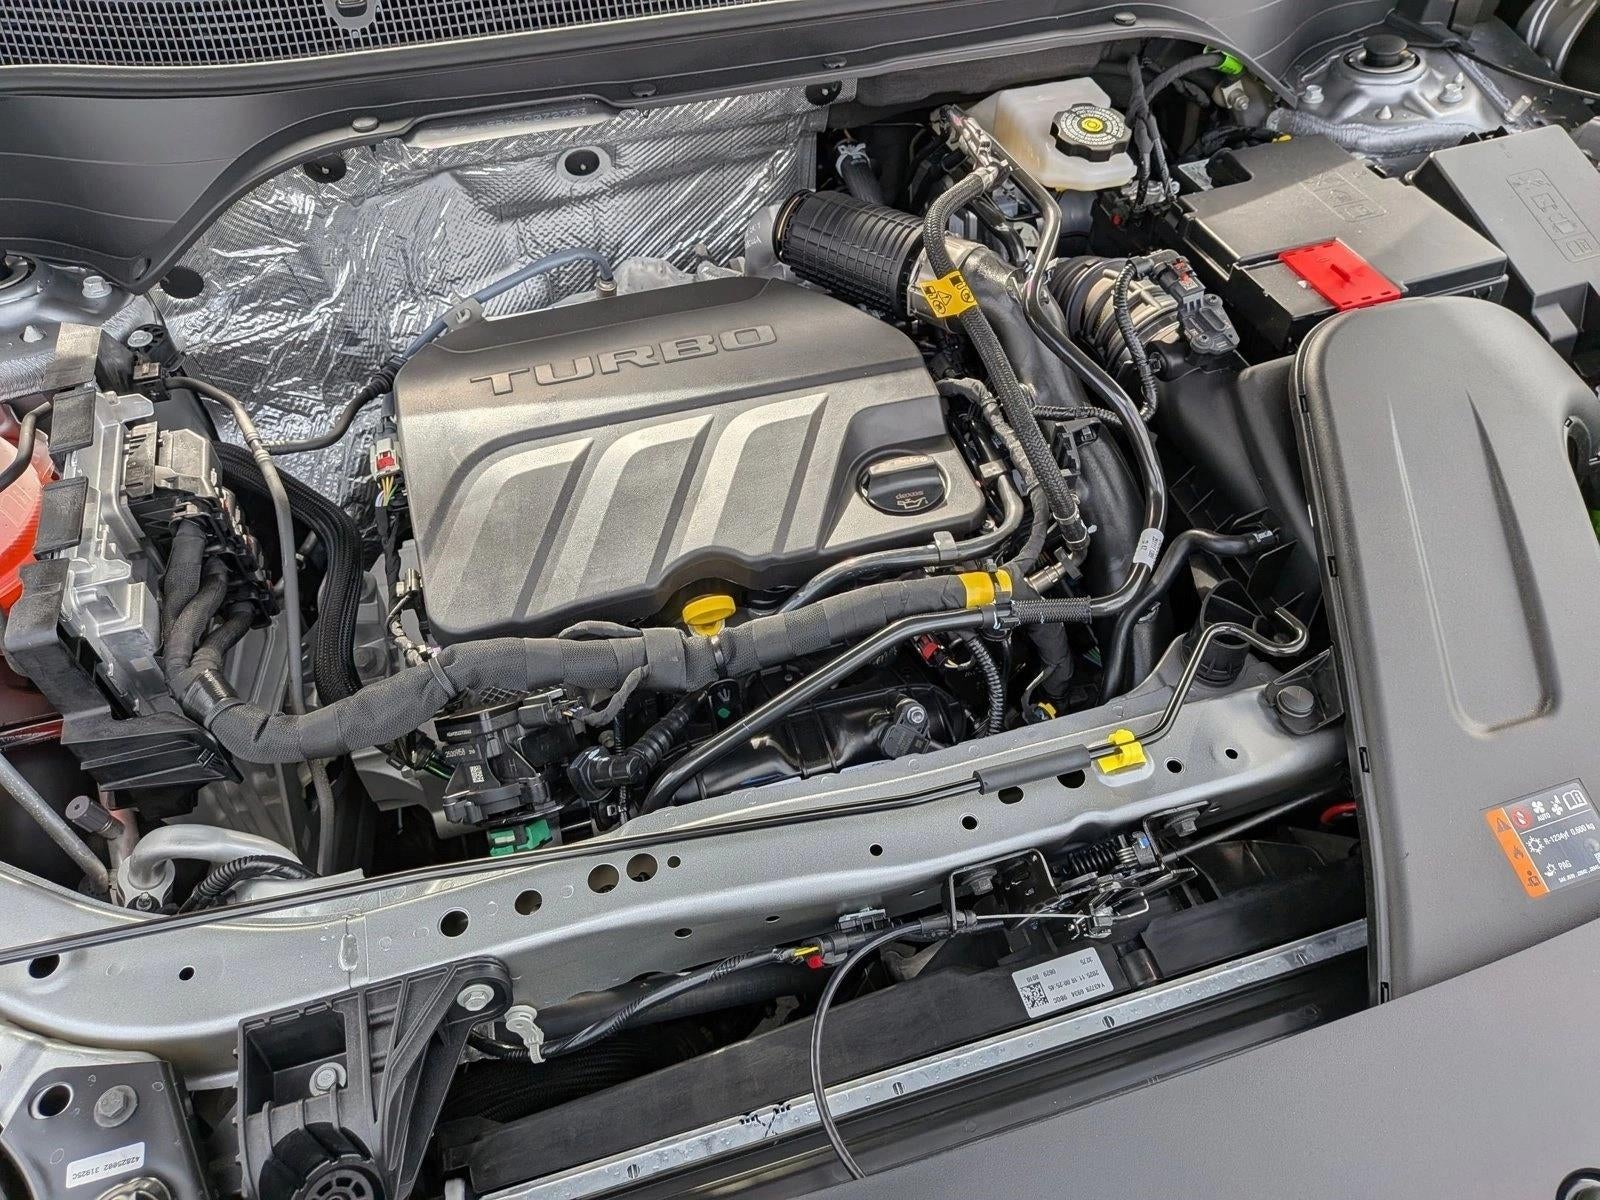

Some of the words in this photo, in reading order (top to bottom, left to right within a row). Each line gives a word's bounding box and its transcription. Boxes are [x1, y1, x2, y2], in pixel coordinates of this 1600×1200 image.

[470, 324, 777, 396] TURBO
[1537, 812, 1551, 822] AUTO
[1543, 832, 1570, 845] R-1234yf
[1558, 860, 1572, 871] PAG
